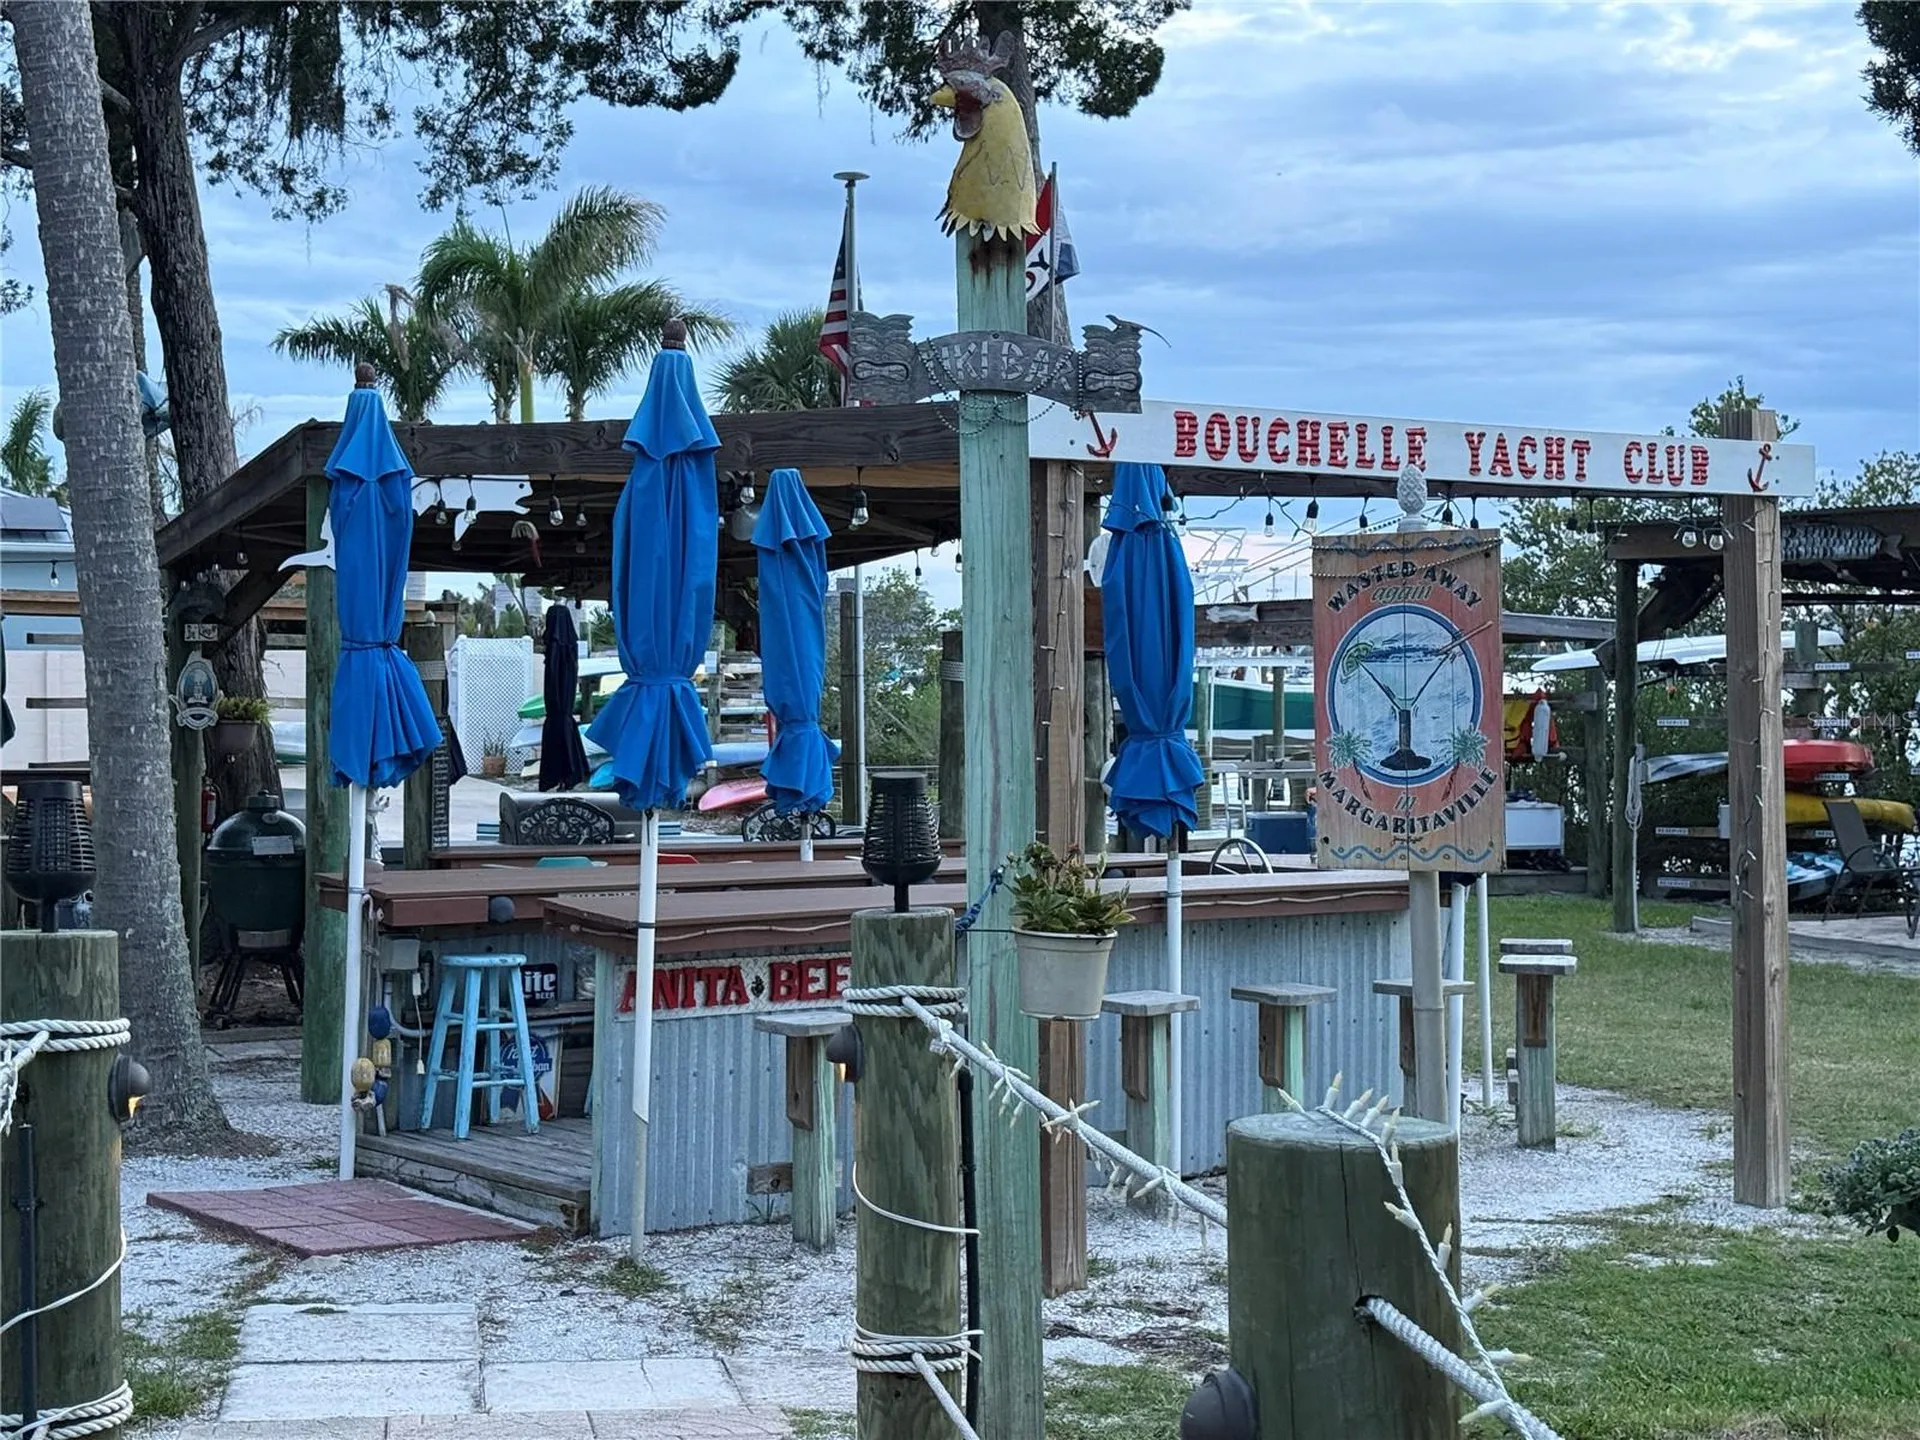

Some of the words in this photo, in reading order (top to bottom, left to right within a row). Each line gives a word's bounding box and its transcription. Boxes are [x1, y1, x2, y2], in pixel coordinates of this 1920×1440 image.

[1002, 342, 1074, 391] BAR
[1174, 410, 1427, 472] BOUCHELLE
[1464, 431, 1592, 482] YACHT
[1623, 441, 1710, 488] CLUB
[1327, 560, 1418, 614] WASTED
[1423, 565, 1483, 610] AWAY
[1371, 583, 1433, 605] again
[1318, 768, 1499, 835] MARGARITAVILLE
[1394, 791, 1417, 811] in
[524, 971, 556, 992] ite
[769, 957, 852, 1002] BEE
